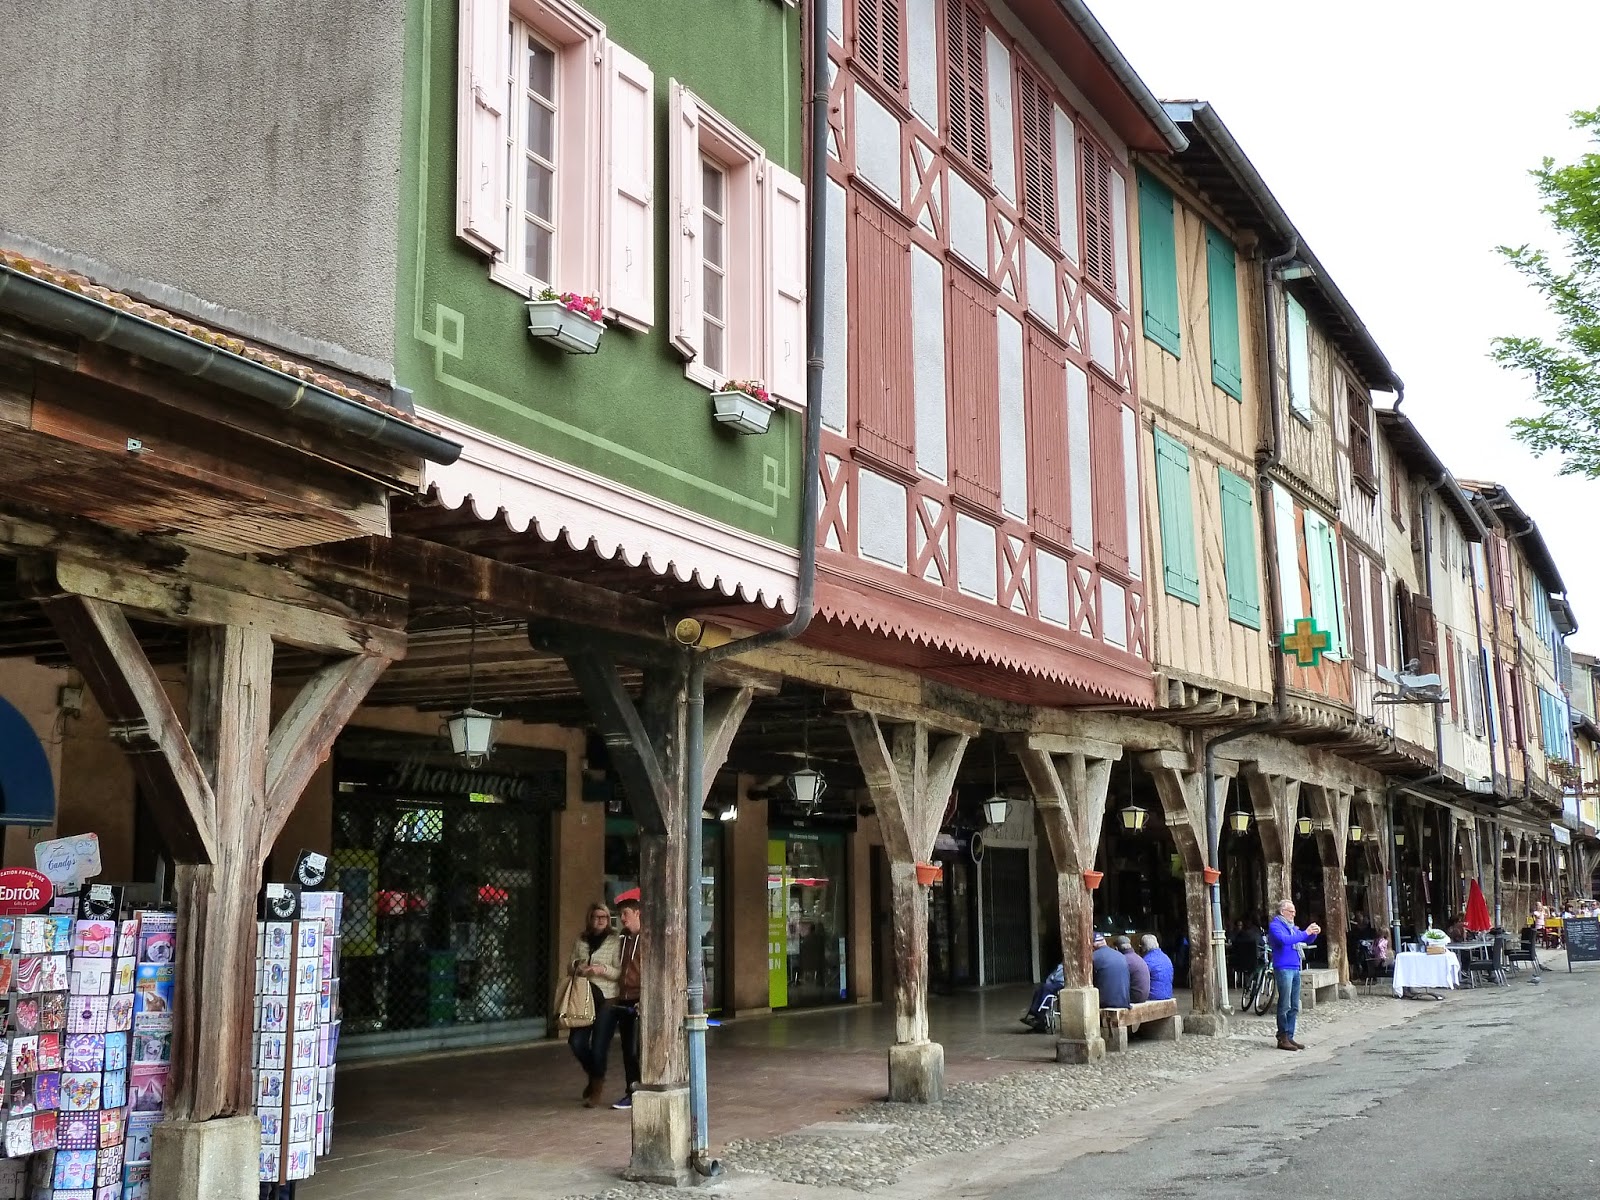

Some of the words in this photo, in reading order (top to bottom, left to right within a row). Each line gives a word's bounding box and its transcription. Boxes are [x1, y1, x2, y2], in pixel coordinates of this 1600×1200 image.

[0, 886, 40, 900] EDITOR
[273, 927, 286, 947] 8
[301, 928, 316, 948] 15
[271, 963, 283, 983] 9
[266, 1002, 284, 1022] 10
[297, 1001, 314, 1021] 17
[265, 1039, 281, 1059] 11
